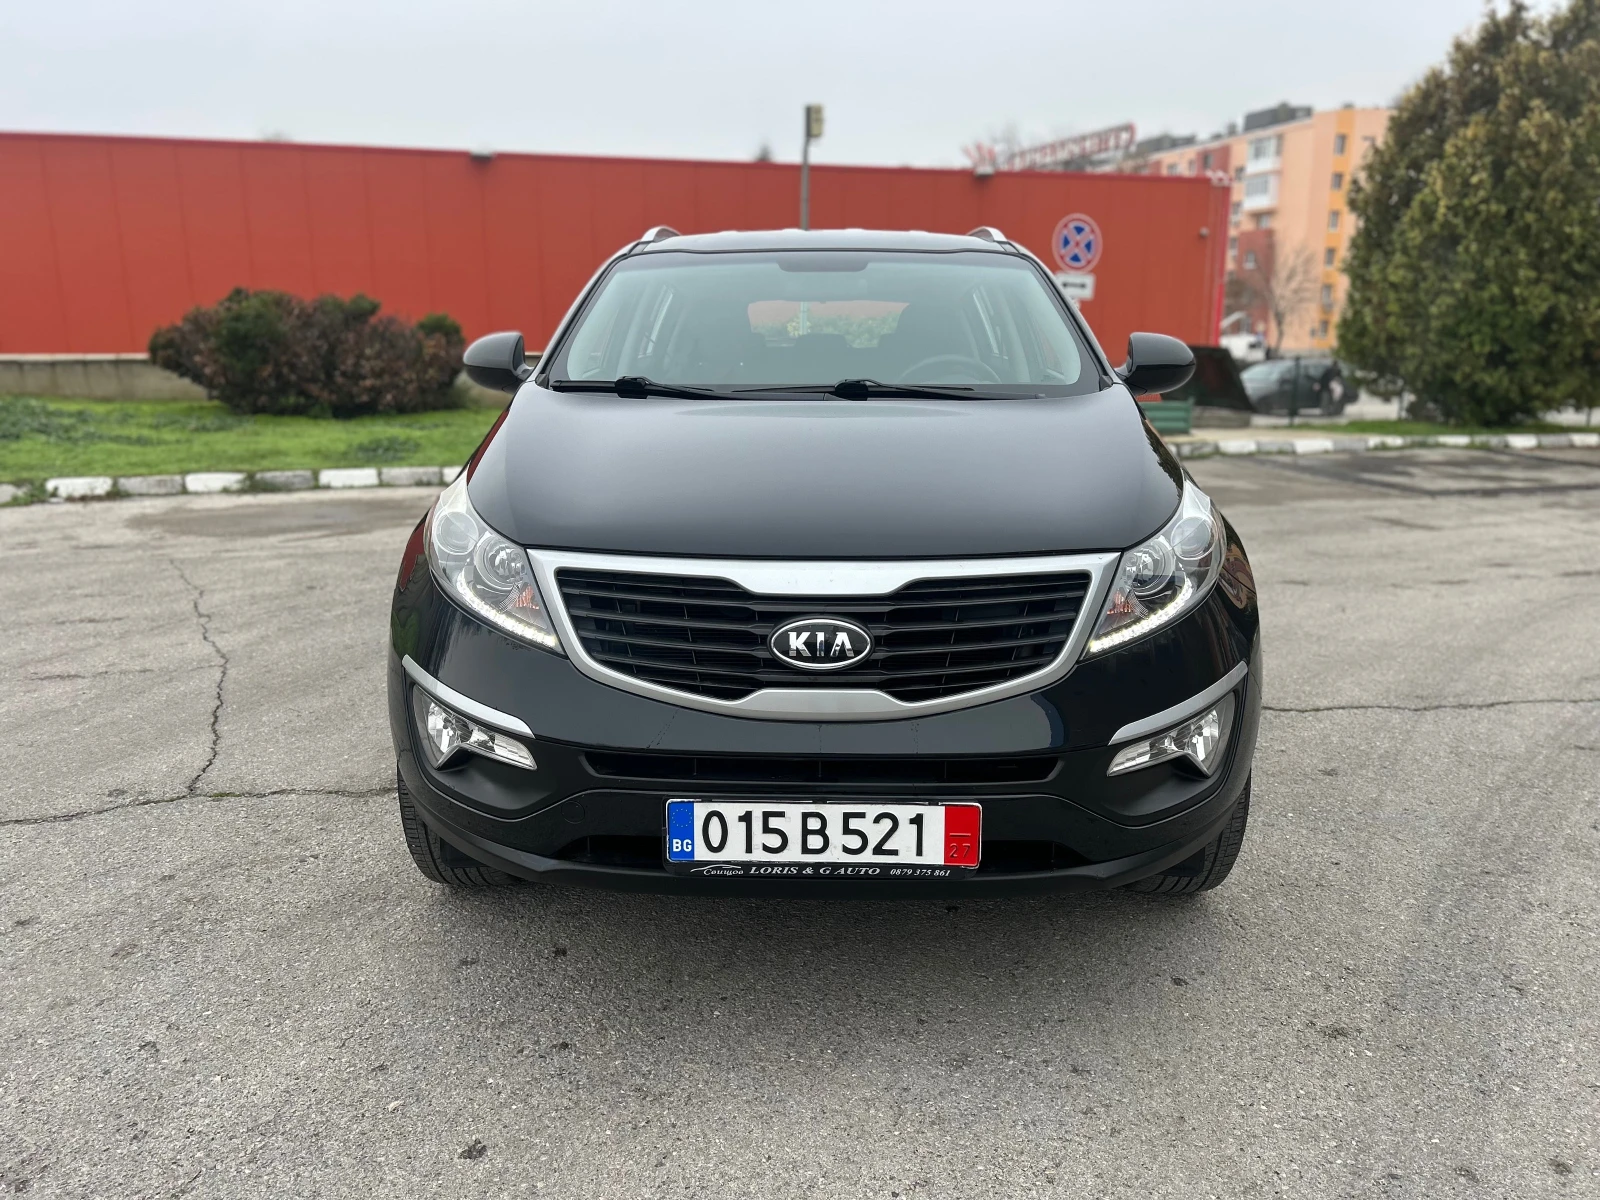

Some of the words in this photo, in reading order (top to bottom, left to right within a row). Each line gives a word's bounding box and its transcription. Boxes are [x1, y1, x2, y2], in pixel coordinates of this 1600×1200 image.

[788, 632, 854, 657] KIA
[672, 839, 692, 852] BG
[949, 843, 971, 858] 27
[749, 866, 799, 875] LORIS
[802, 867, 814, 875] &
[819, 867, 831, 875] G
[834, 867, 880, 875] AUTO
[890, 868, 912, 876] 0879
[934, 869, 951, 877] 861
